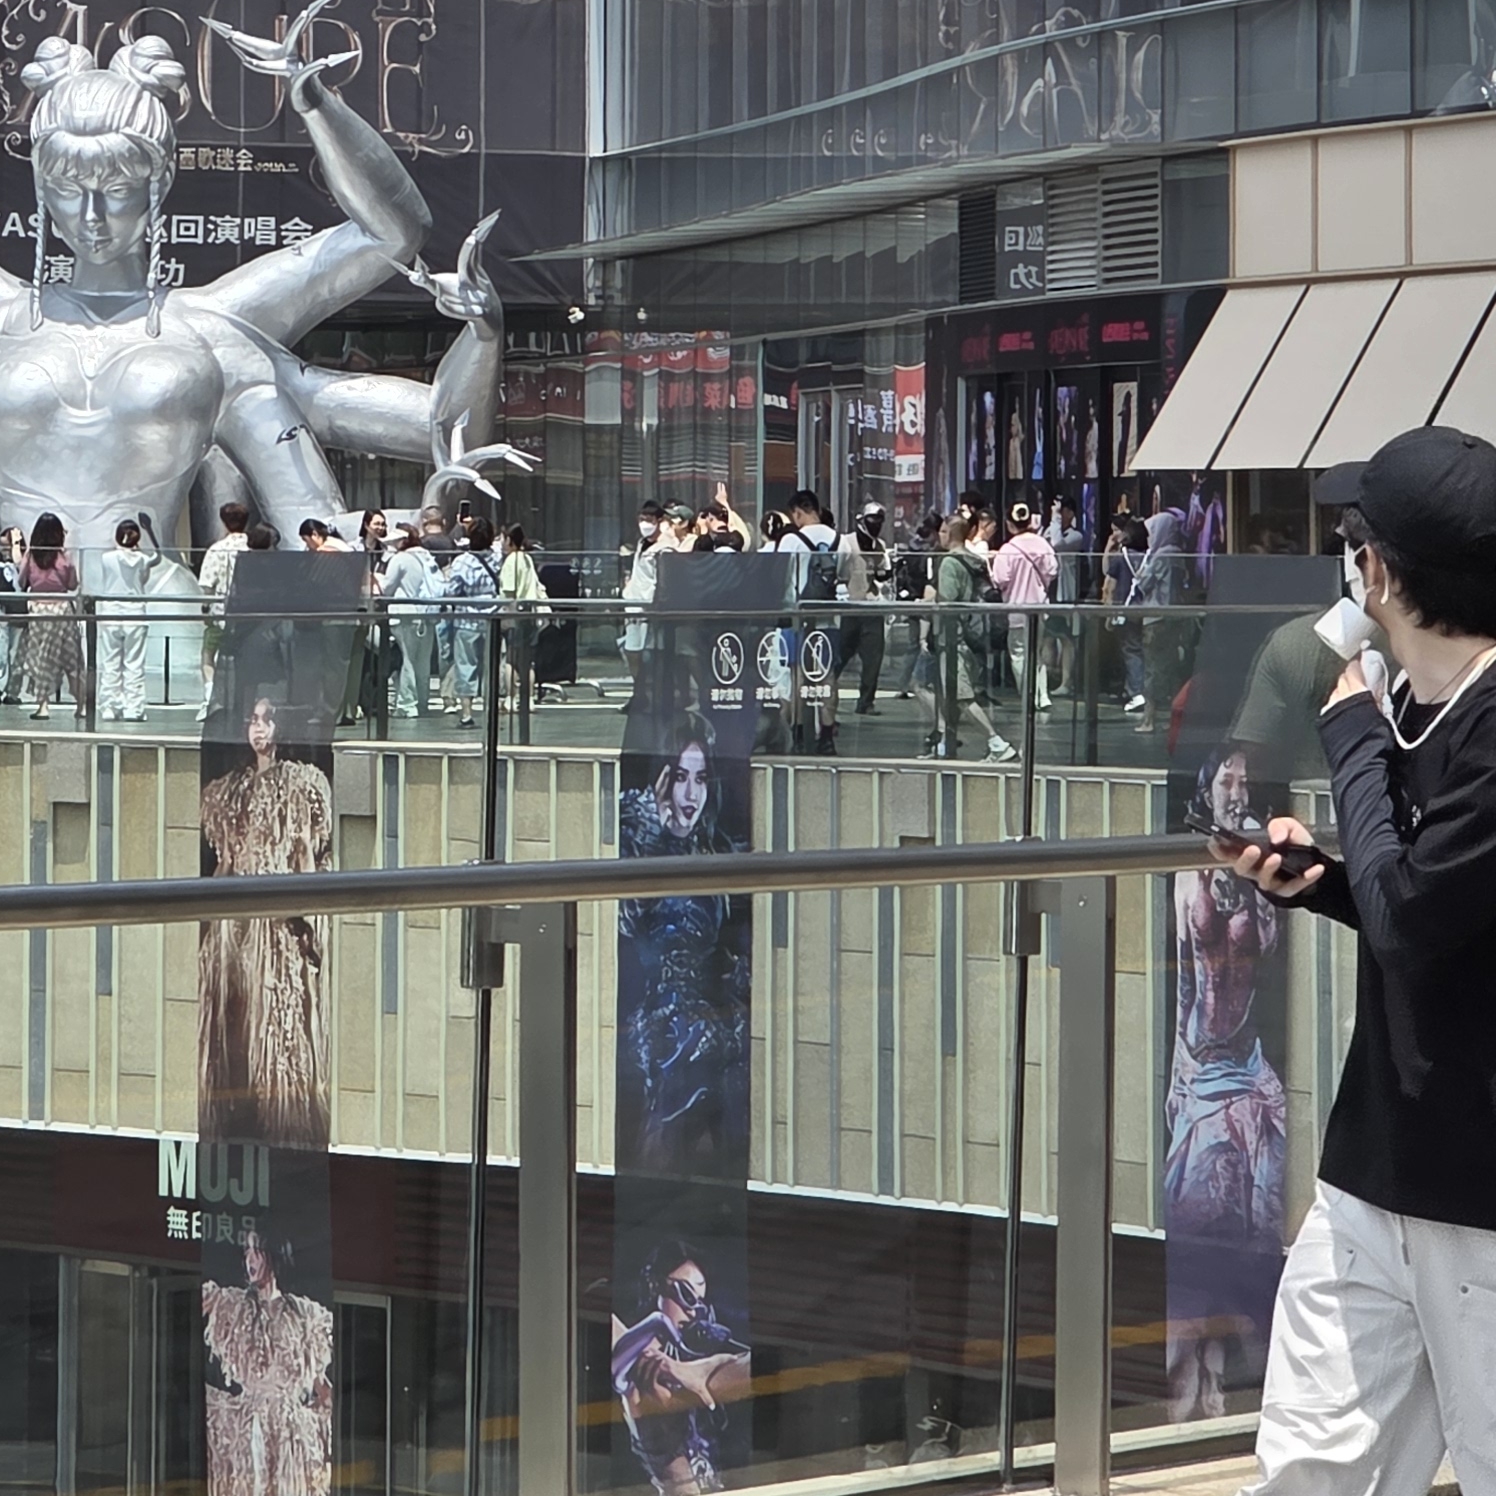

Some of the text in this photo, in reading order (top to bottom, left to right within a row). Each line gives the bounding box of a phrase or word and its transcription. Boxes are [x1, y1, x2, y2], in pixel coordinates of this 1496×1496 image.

[158, 1138, 270, 1207] MUJI
[166, 1205, 260, 1247] 無印良品
